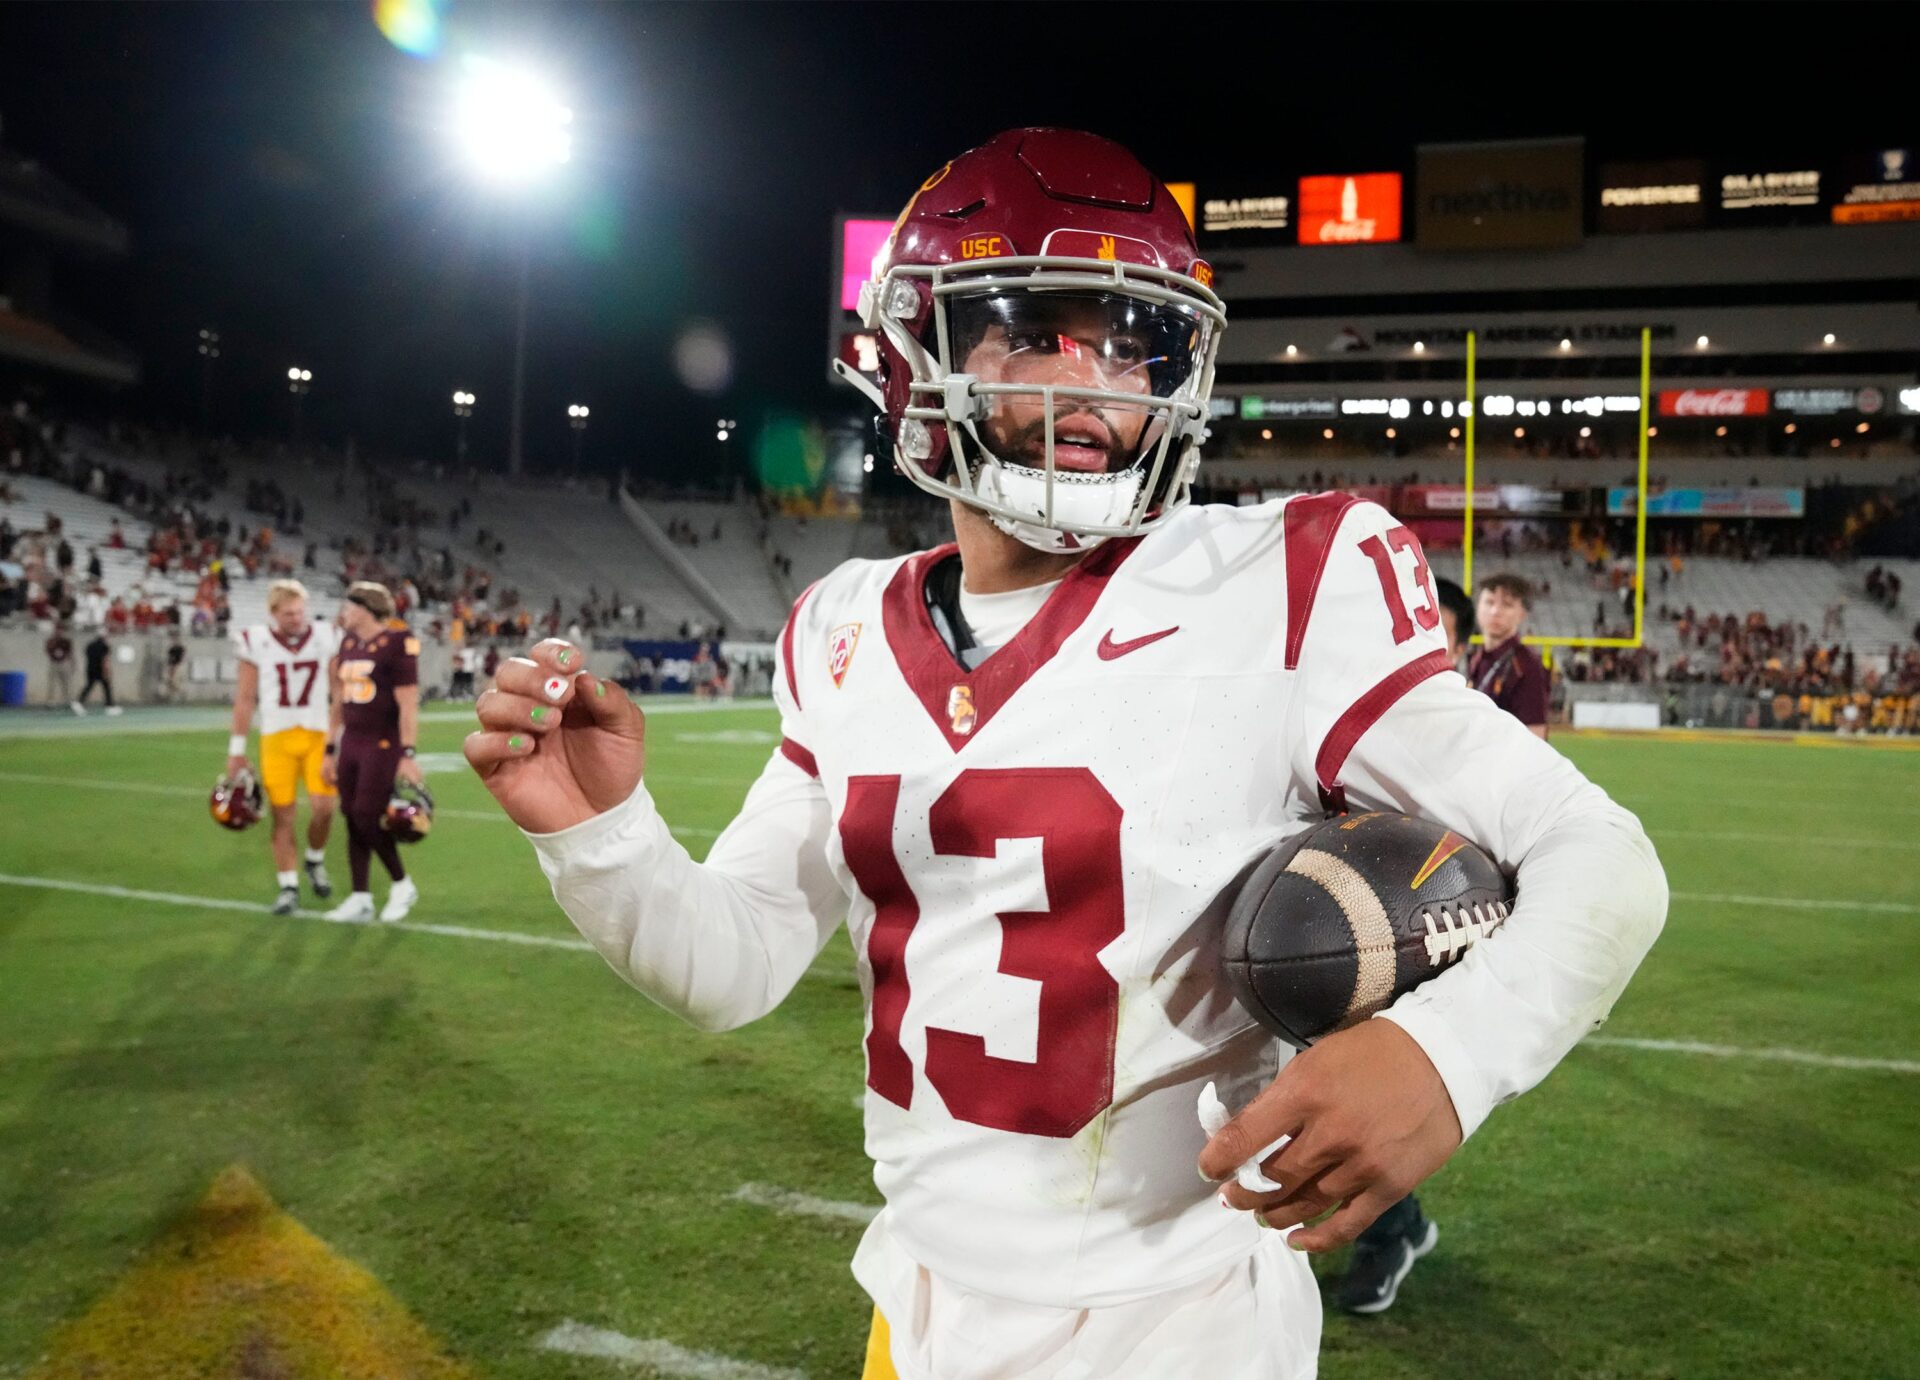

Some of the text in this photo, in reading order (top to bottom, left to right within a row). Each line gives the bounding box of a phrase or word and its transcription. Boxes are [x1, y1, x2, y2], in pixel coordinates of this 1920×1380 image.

[961, 237, 1001, 259] USC
[1195, 263, 1212, 288] USC
[1357, 525, 1439, 645] 13
[276, 661, 319, 708] 17
[838, 766, 1125, 1139] 13
